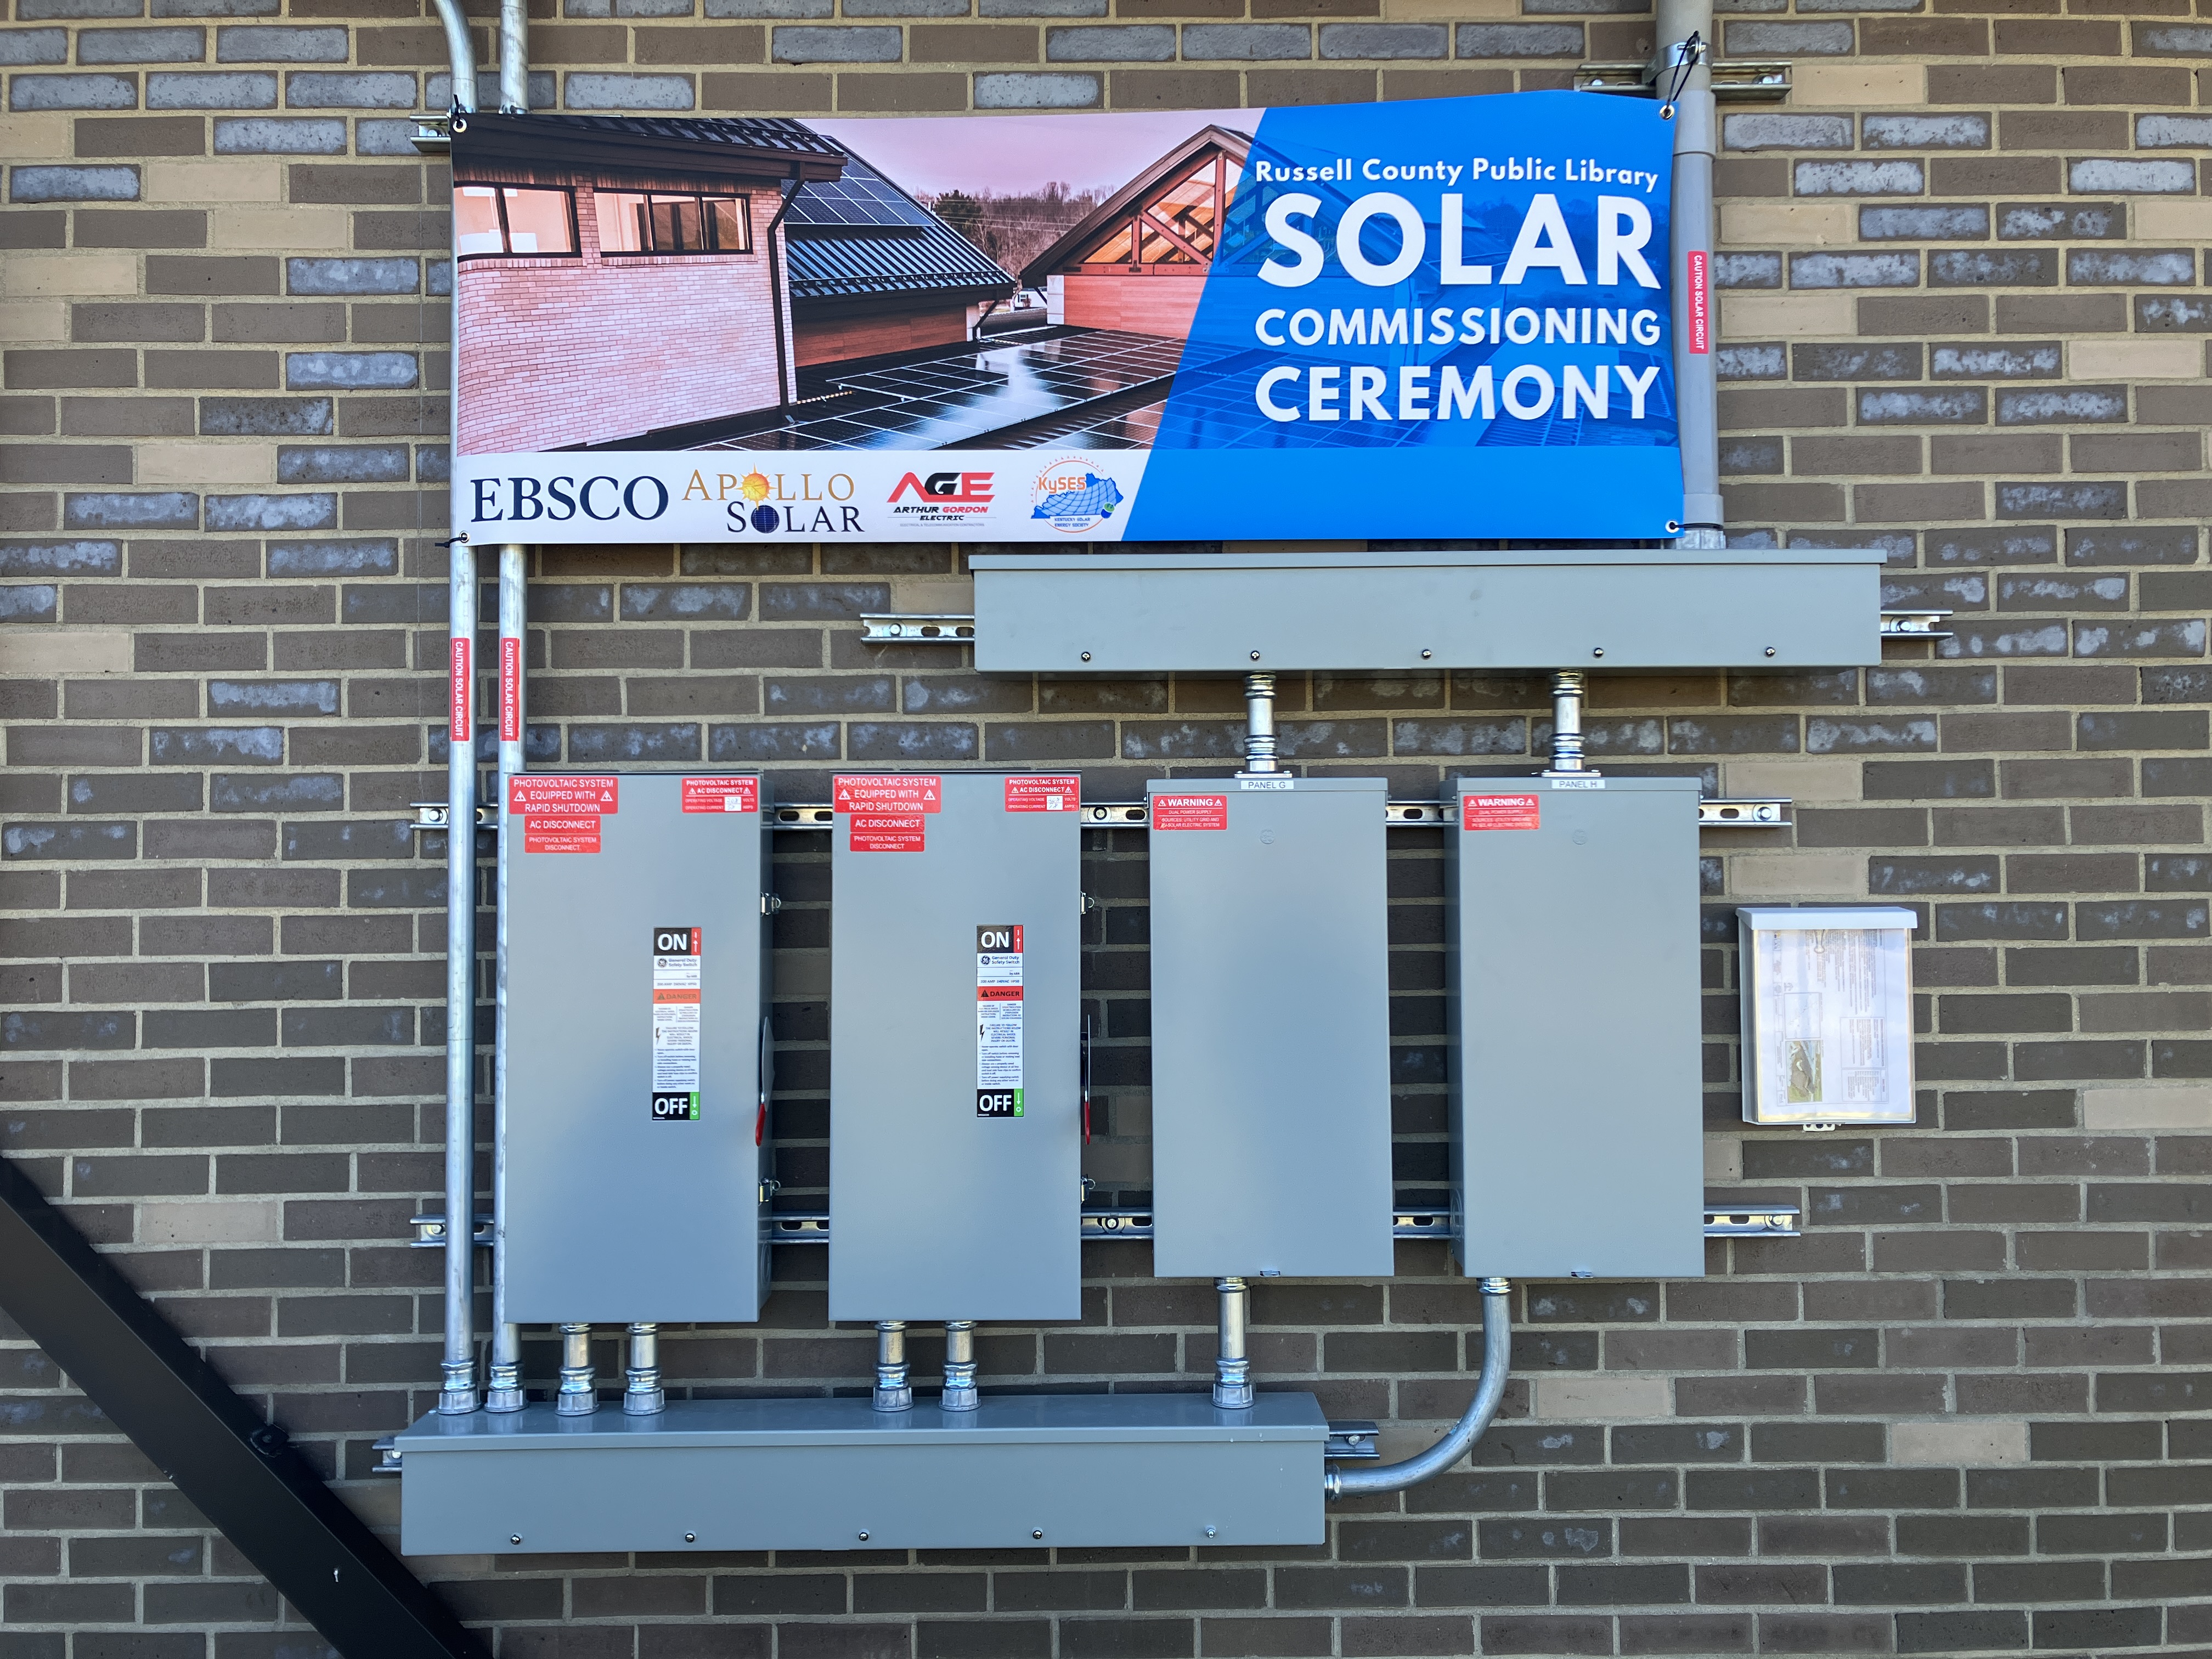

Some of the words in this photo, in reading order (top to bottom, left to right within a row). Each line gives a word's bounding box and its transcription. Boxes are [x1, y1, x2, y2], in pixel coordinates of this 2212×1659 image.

[1256, 159, 1352, 182] Russell
[1362, 159, 1464, 186] County
[1473, 157, 1555, 181] Public
[1566, 159, 1658, 193] Library
[1257, 192, 1661, 289] SOLAR
[1694, 255, 1703, 289] CAUTION
[1695, 291, 1704, 317] SOLAR
[1255, 308, 1660, 346] COMMISSIONING
[1696, 319, 1705, 349] CIRCUIT
[1255, 364, 1660, 422] CEREMONY
[681, 466, 855, 501] APOLLO
[887, 472, 995, 503] AGE
[1039, 477, 1086, 494] KySES
[470, 476, 669, 523] EBSCO
[726, 501, 865, 533] SOLAR
[505, 641, 514, 676] CAUTION
[455, 706, 463, 737] CIRCUIT
[505, 706, 513, 737] CIRCUIT
[514, 779, 577, 788] PHOTOVOLTAIC
[579, 779, 613, 787] SYSTEM
[838, 778, 901, 786] PHOTOVOLTAIC
[902, 778, 936, 786] SYSTEM
[854, 789, 896, 798] EQUIPPED
[898, 789, 919, 798] WITH
[525, 804, 550, 812] RAPID
[552, 804, 600, 812] SHUTDOWN
[530, 791, 573, 800] EQUIPPED
[574, 791, 596, 799] WITH
[849, 802, 874, 811] RAPID
[876, 802, 923, 811] SHUTDOWN
[530, 820, 541, 829] AC
[543, 820, 596, 829] DISCONNECT
[855, 819, 867, 828] AC
[868, 819, 920, 828] DISCONNECT
[658, 934, 687, 951] ON
[981, 932, 1009, 948] ON
[654, 1098, 688, 1115] OFF
[979, 1094, 1012, 1111] OFF
